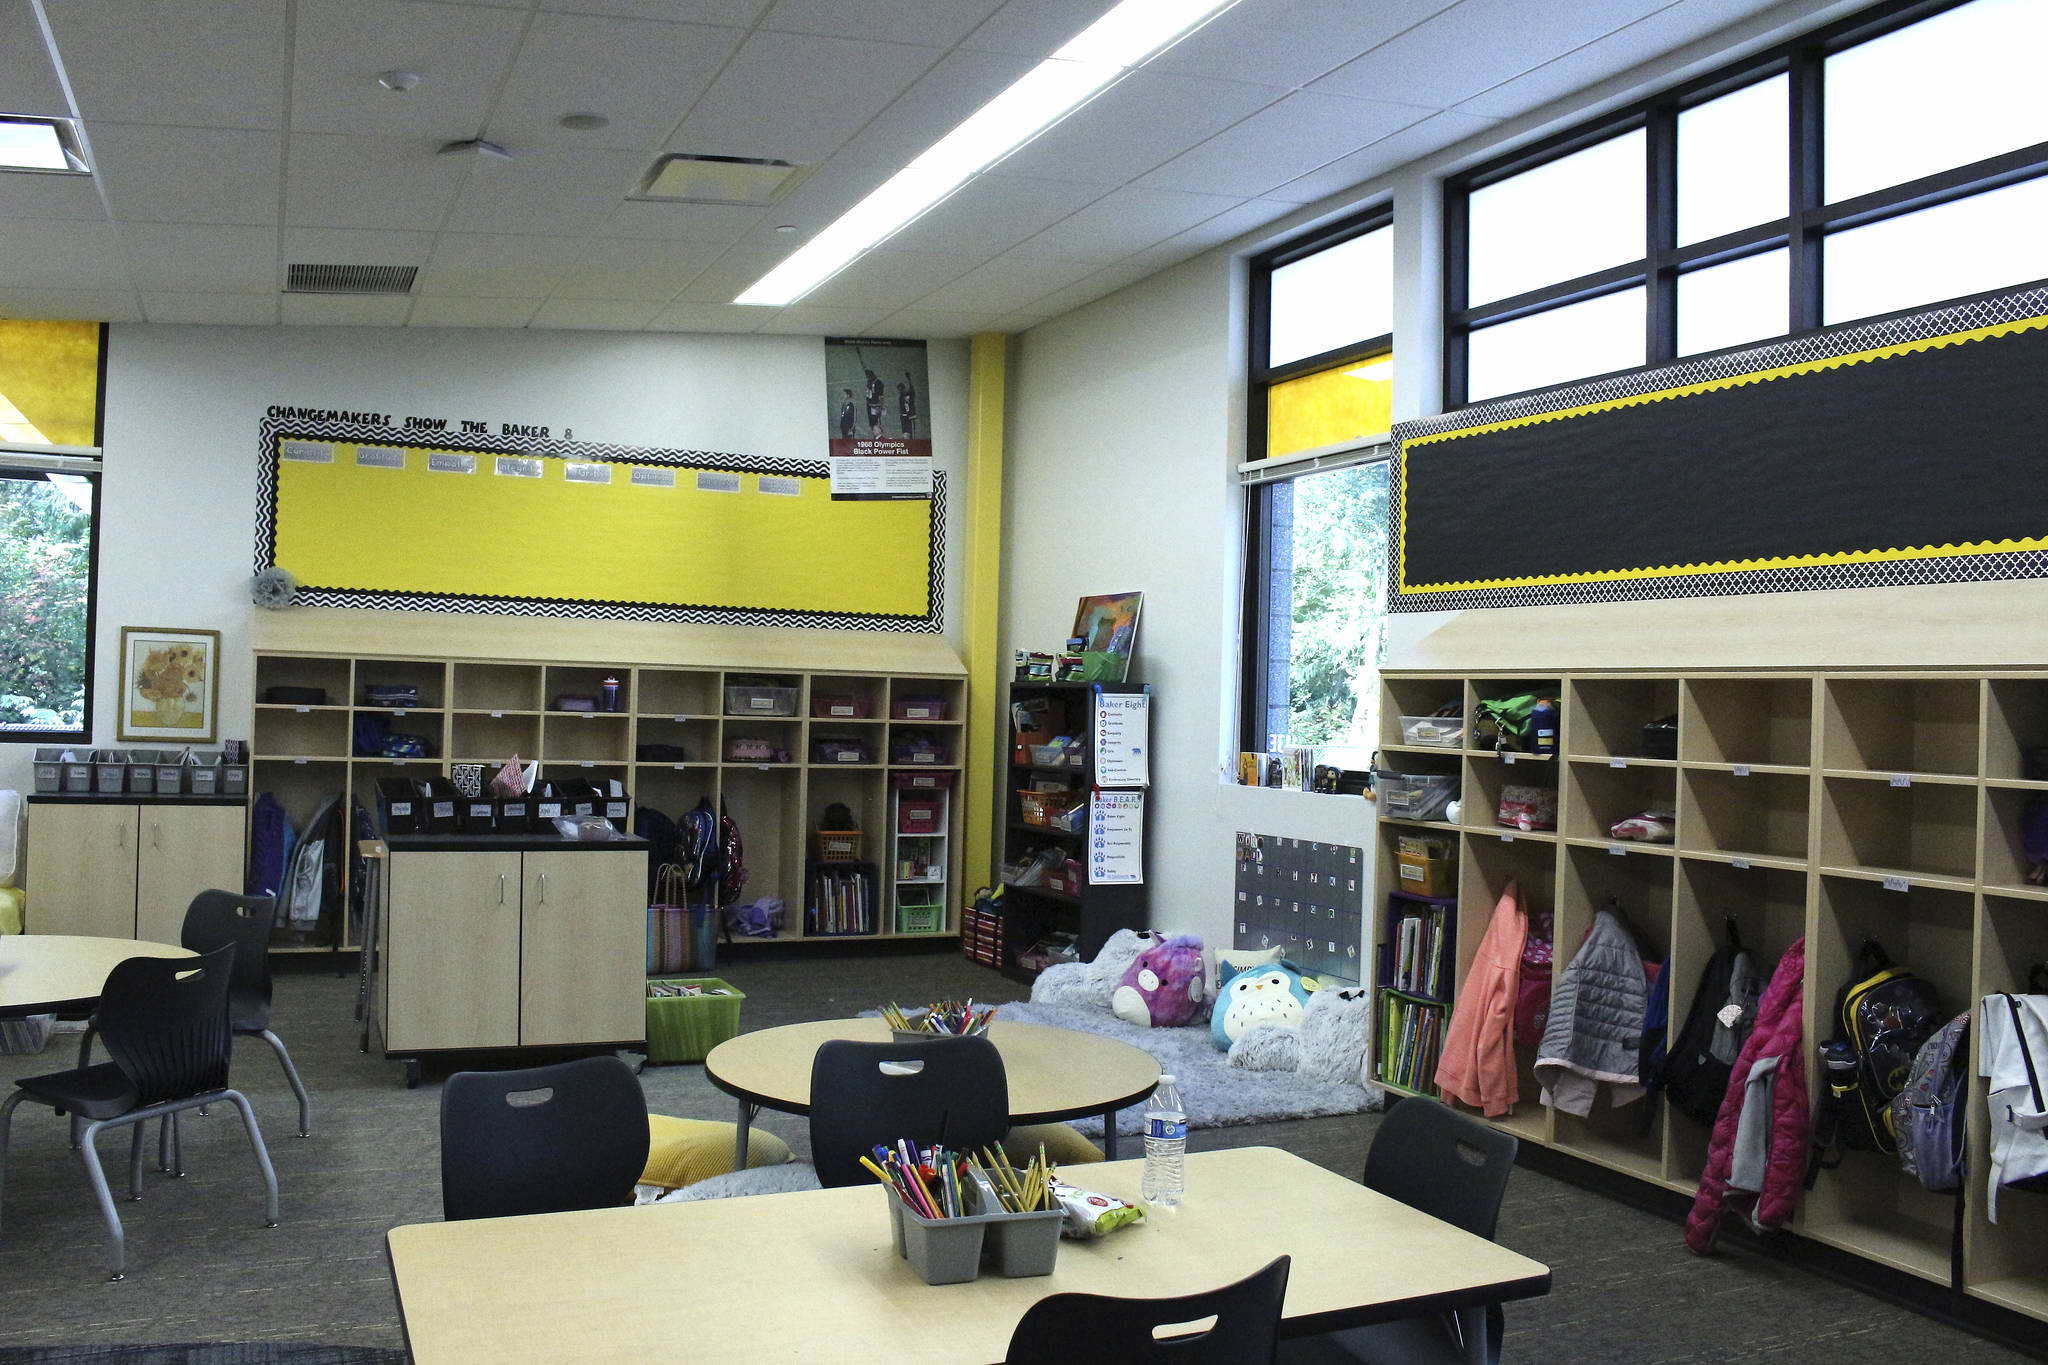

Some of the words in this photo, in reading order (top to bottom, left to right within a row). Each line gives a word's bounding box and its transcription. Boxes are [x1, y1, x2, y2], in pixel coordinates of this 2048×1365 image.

[267, 405, 391, 426] CHANGEMAKERS
[404, 416, 447, 430] SHOW
[461, 420, 488, 433] THE
[502, 423, 549, 438] BAKER
[564, 428, 573, 440] 8
[874, 441, 905, 449] Olympics
[1125, 700, 1145, 710] Eight
